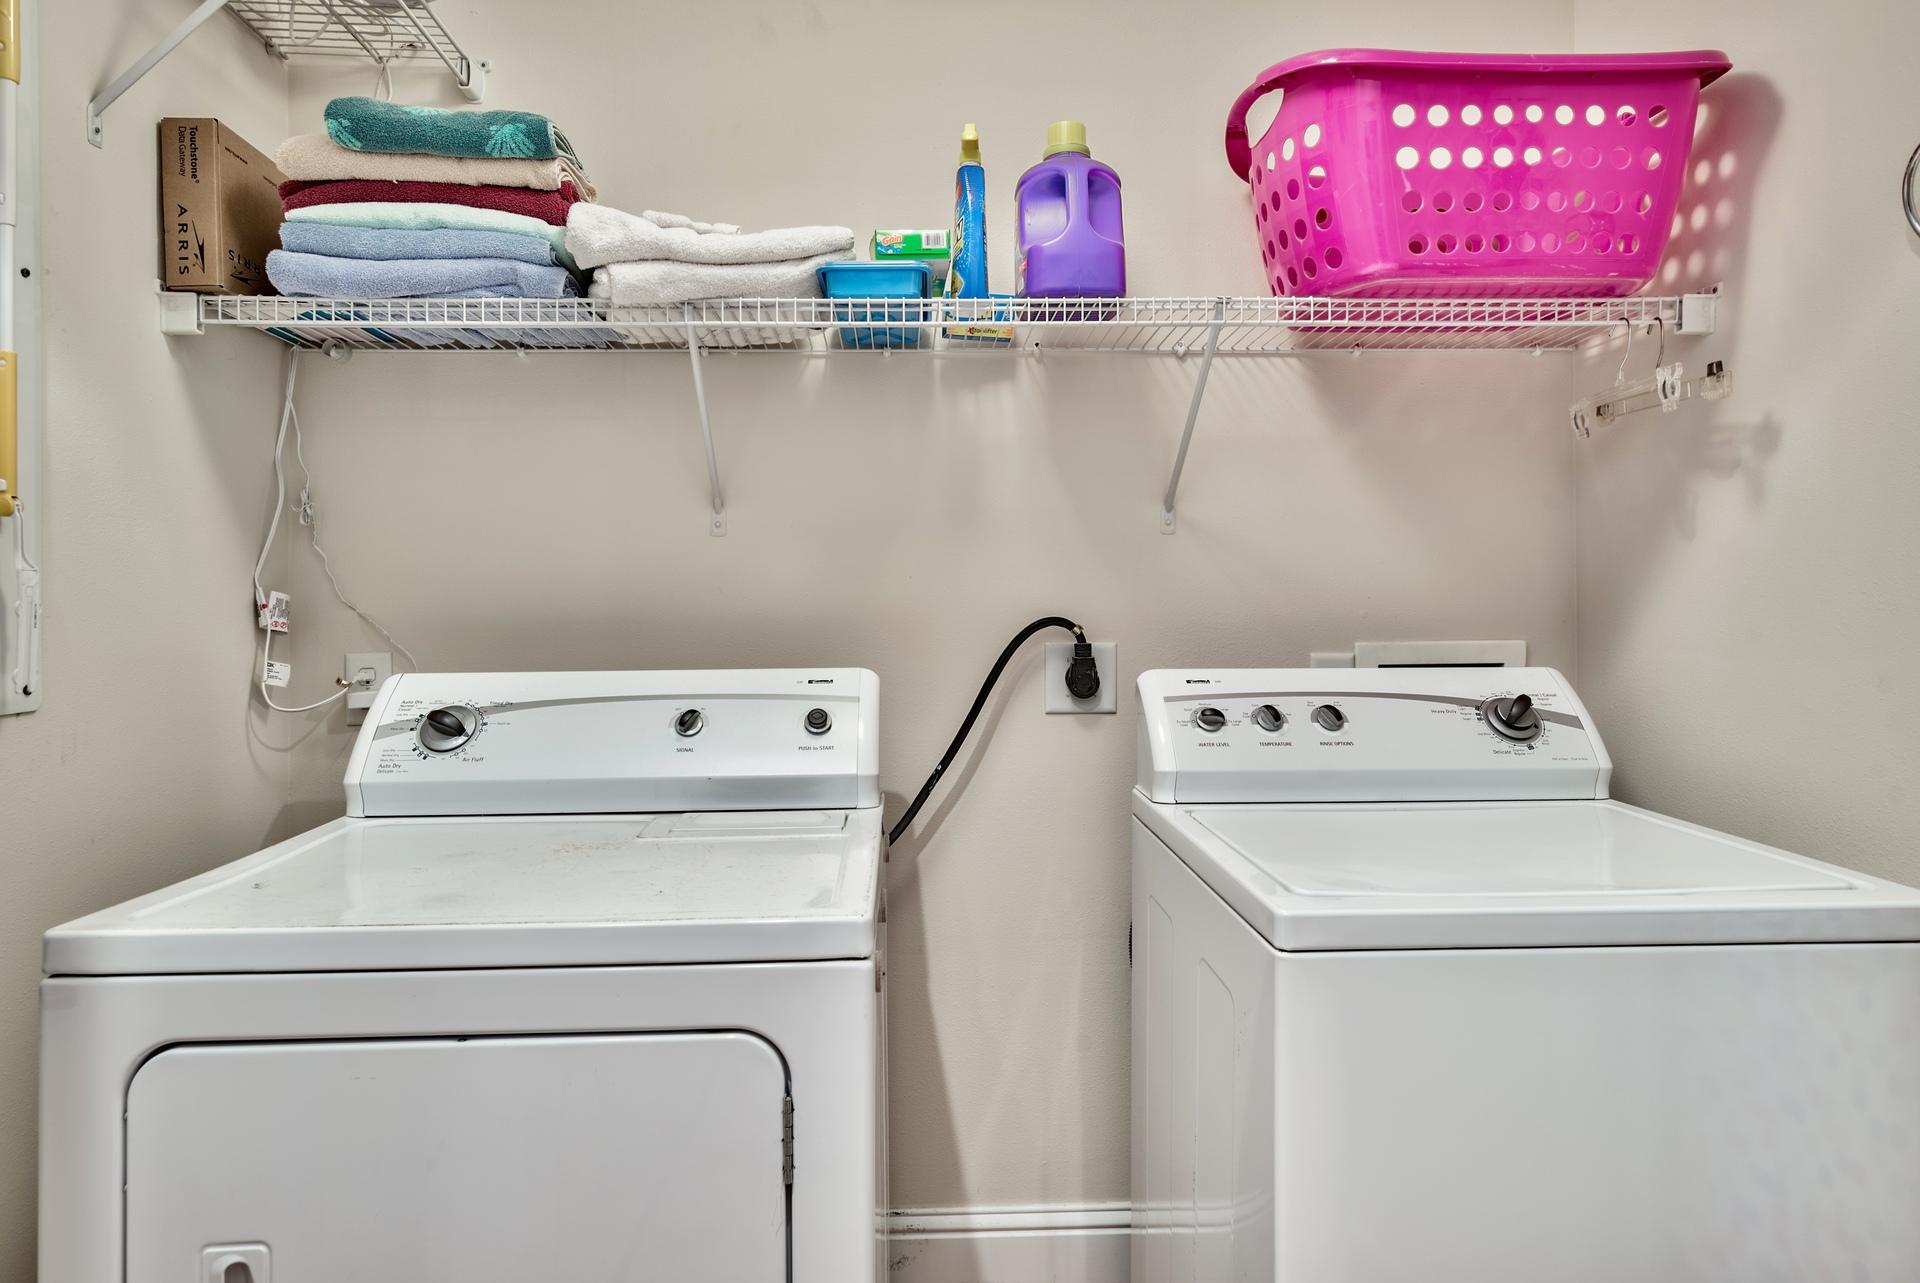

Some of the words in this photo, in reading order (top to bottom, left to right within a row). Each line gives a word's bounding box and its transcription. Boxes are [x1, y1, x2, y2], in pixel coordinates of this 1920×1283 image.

[178, 126, 187, 143] Data
[178, 144, 187, 177] Gateway
[177, 203, 190, 275] ARRIS
[881, 235, 902, 246] Gain
